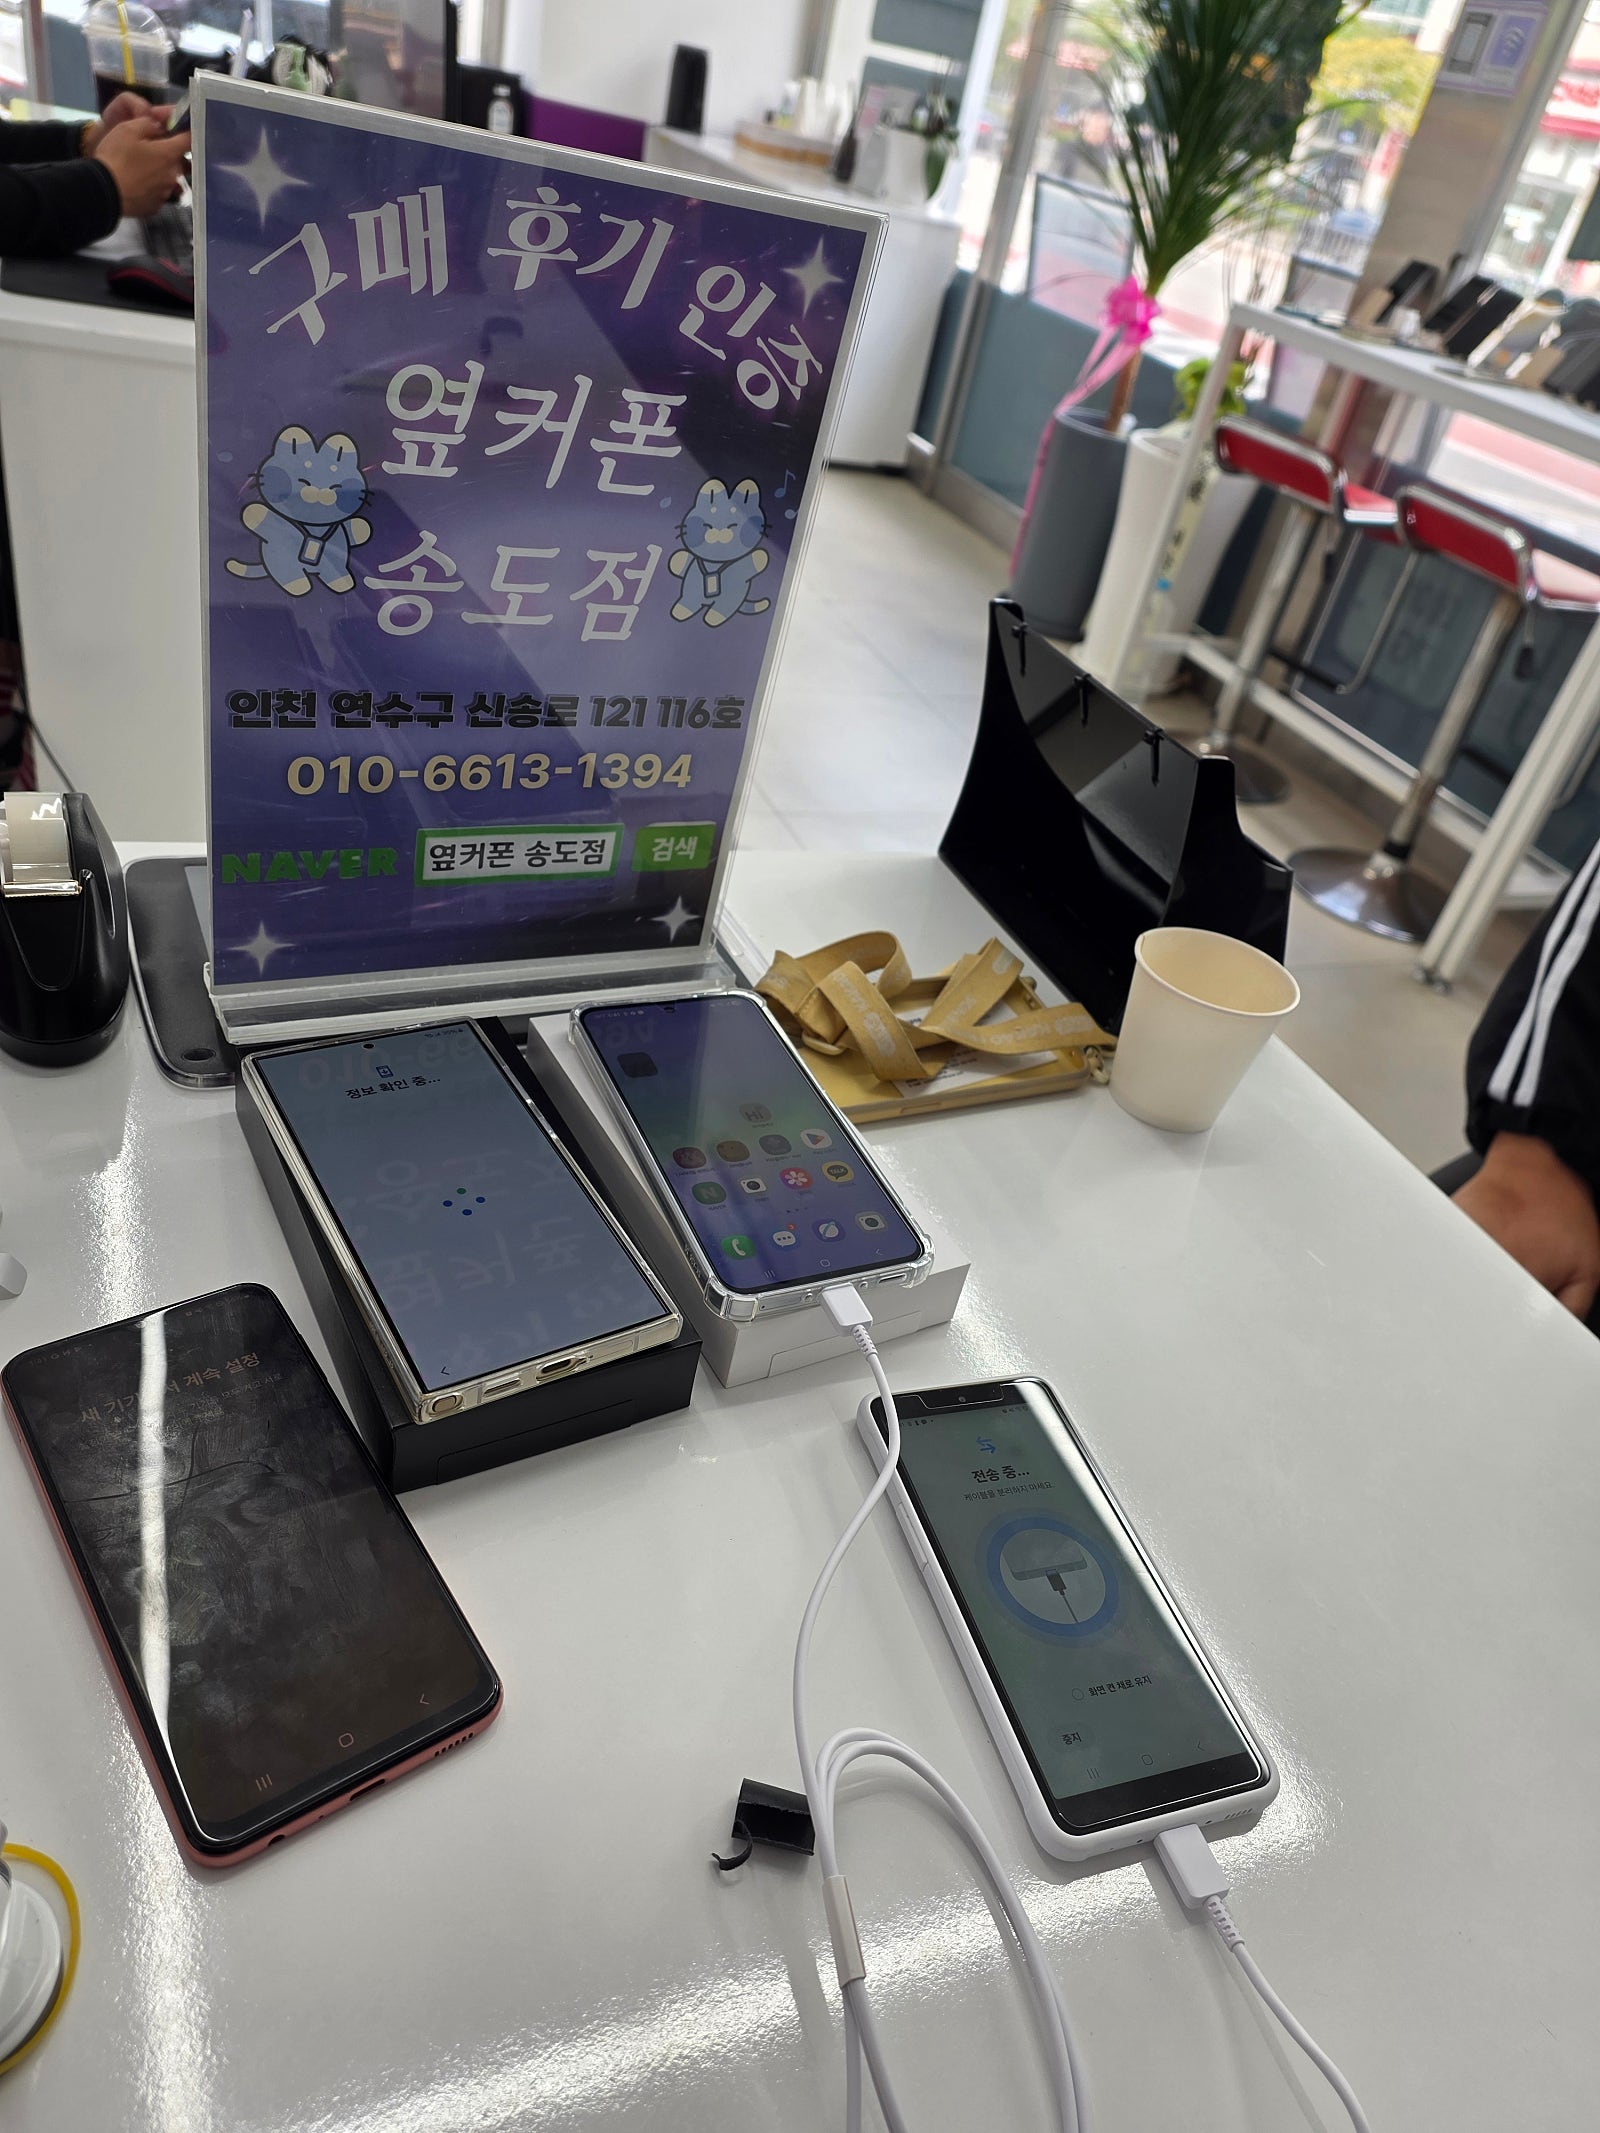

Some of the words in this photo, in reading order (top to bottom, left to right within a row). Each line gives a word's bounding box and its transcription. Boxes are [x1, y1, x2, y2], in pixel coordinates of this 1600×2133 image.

[248, 184, 449, 346] 구매
[486, 187, 675, 309] 후기
[679, 265, 824, 410] 인증
[381, 359, 688, 496] 옆커폰
[363, 530, 663, 643] 송도점
[227, 689, 317, 729] 인천
[331, 690, 455, 729] 연수구
[465, 692, 580, 728] 신송로
[590, 695, 649, 728] 121
[657, 695, 745, 729] 116호
[287, 752, 693, 795] 010-6613-1394
[221, 847, 398, 874] NAVER
[429, 840, 515, 872] 옆커폰
[524, 838, 606, 868] 송도점
[651, 836, 698, 862] 검색
[345, 1086, 377, 1099] 정보
[378, 1079, 410, 1092] 확인
[80, 1407, 101, 1424] 새
[105, 1379, 181, 1414] 기기서
[183, 1365, 222, 1388] 계속
[224, 1352, 261, 1375] 설정
[971, 1468, 1000, 1483] 전송
[1088, 1684, 1107, 1697] 화면
[1107, 1682, 1117, 1693] 켠
[1116, 1679, 1134, 1691] 채로
[1134, 1674, 1153, 1687] 유지
[1061, 1732, 1082, 1746] 중지
